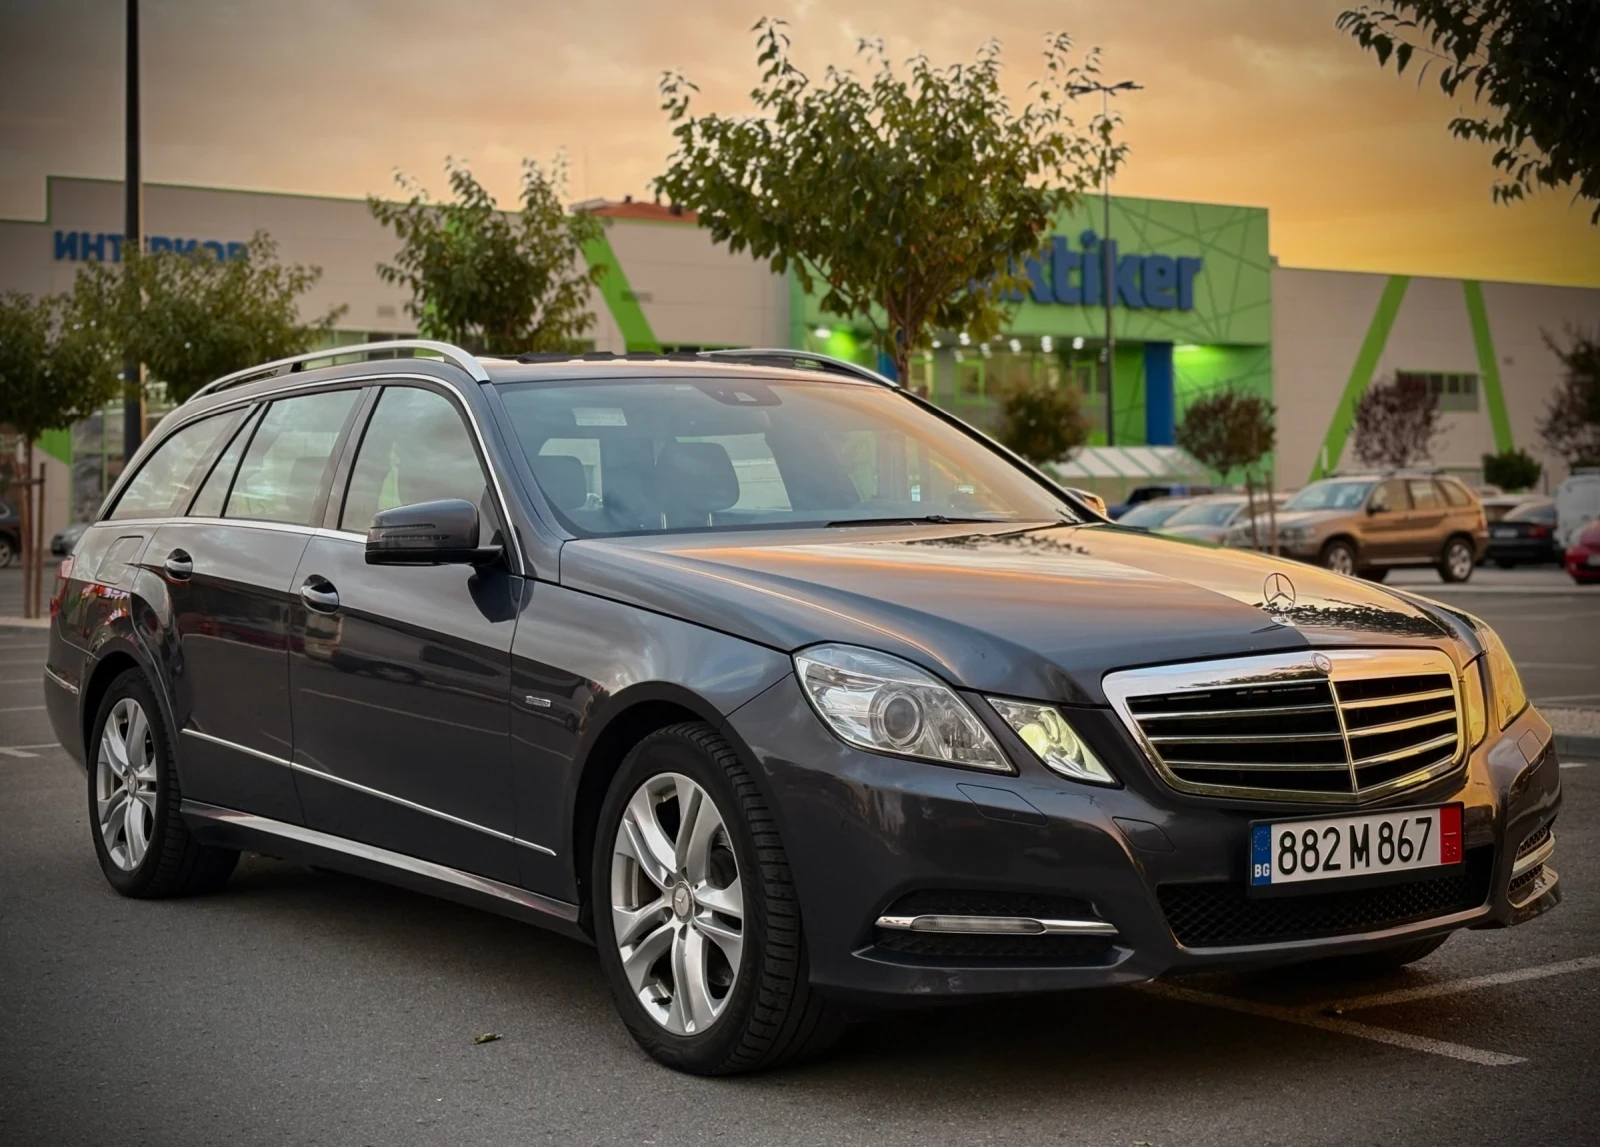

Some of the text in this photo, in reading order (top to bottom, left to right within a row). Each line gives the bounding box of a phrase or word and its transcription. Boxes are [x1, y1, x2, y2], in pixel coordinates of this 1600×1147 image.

[53, 230, 249, 264] ИНТРИОР
[1278, 816, 1432, 875] 882 M 867
[1254, 863, 1270, 877] BG
